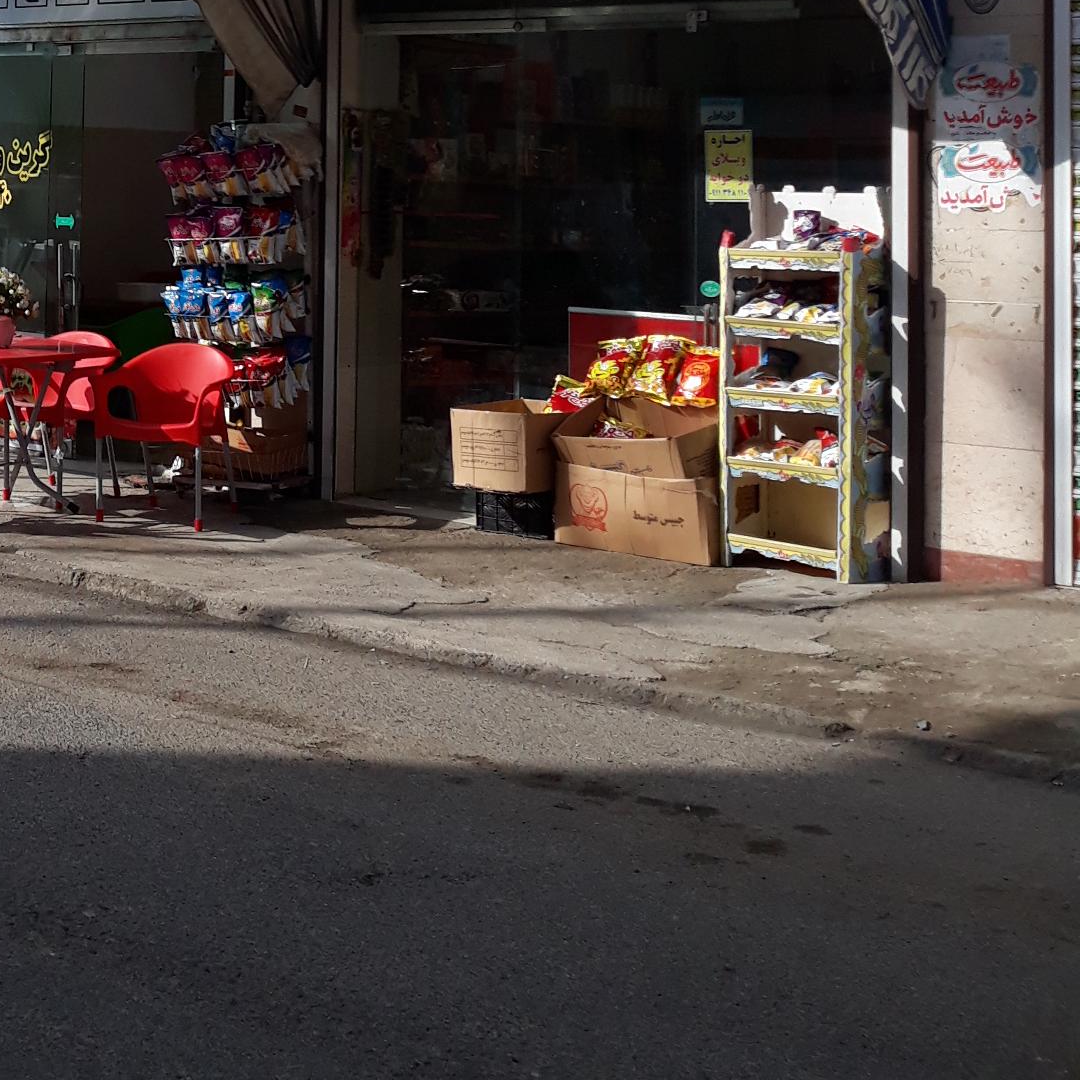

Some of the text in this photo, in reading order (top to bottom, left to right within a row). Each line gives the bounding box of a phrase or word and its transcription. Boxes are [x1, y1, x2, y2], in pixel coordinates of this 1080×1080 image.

[956, 69, 1021, 98] طبیعت
[986, 105, 1038, 129] خوش
[711, 134, 746, 148] اجاره
[6, 130, 53, 183] گرین
[711, 152, 746, 167] ویلای
[956, 148, 1022, 178] طبیعت
[738, 173, 750, 186] دو
[940, 184, 989, 210] آمدید
